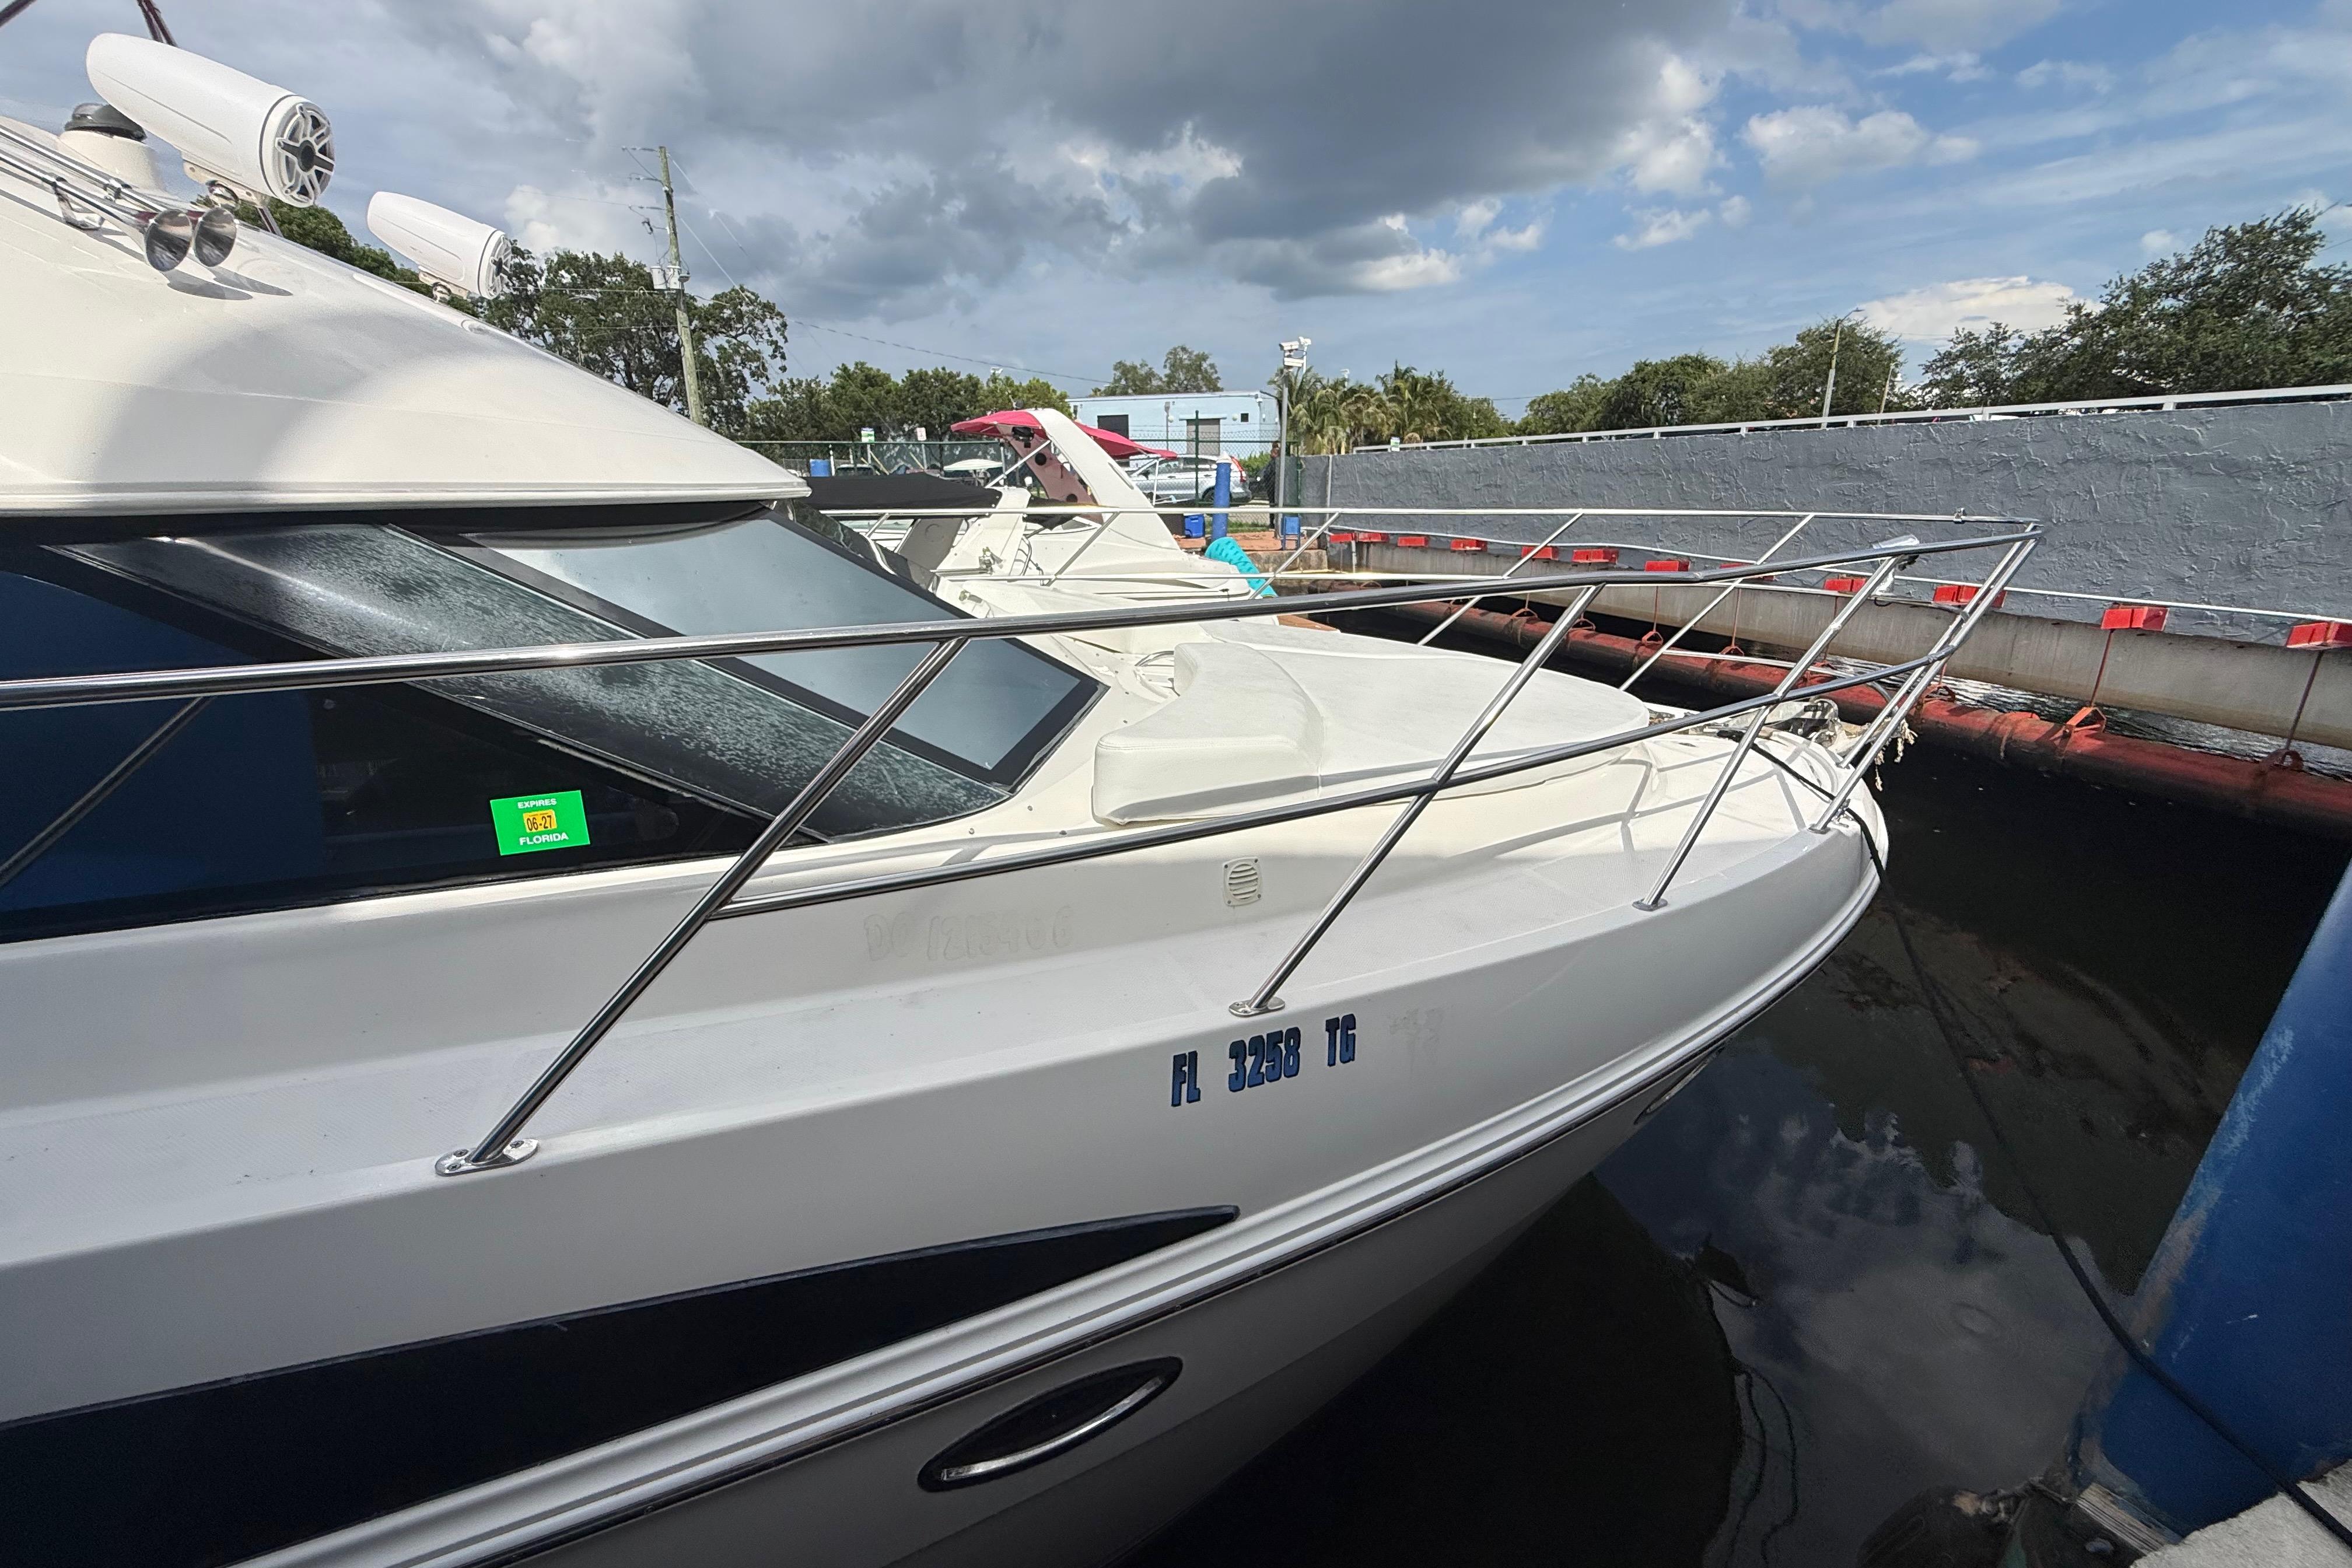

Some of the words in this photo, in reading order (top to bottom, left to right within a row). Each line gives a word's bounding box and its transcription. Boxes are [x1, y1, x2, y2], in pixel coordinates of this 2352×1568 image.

[517, 798, 557, 808] EXPIRES
[527, 815, 552, 831] 06-27
[519, 832, 569, 846] FLORIDA
[1171, 1050, 1200, 1107] FL
[1228, 1027, 1301, 1093] 3258
[1325, 1013, 1357, 1067] TG
